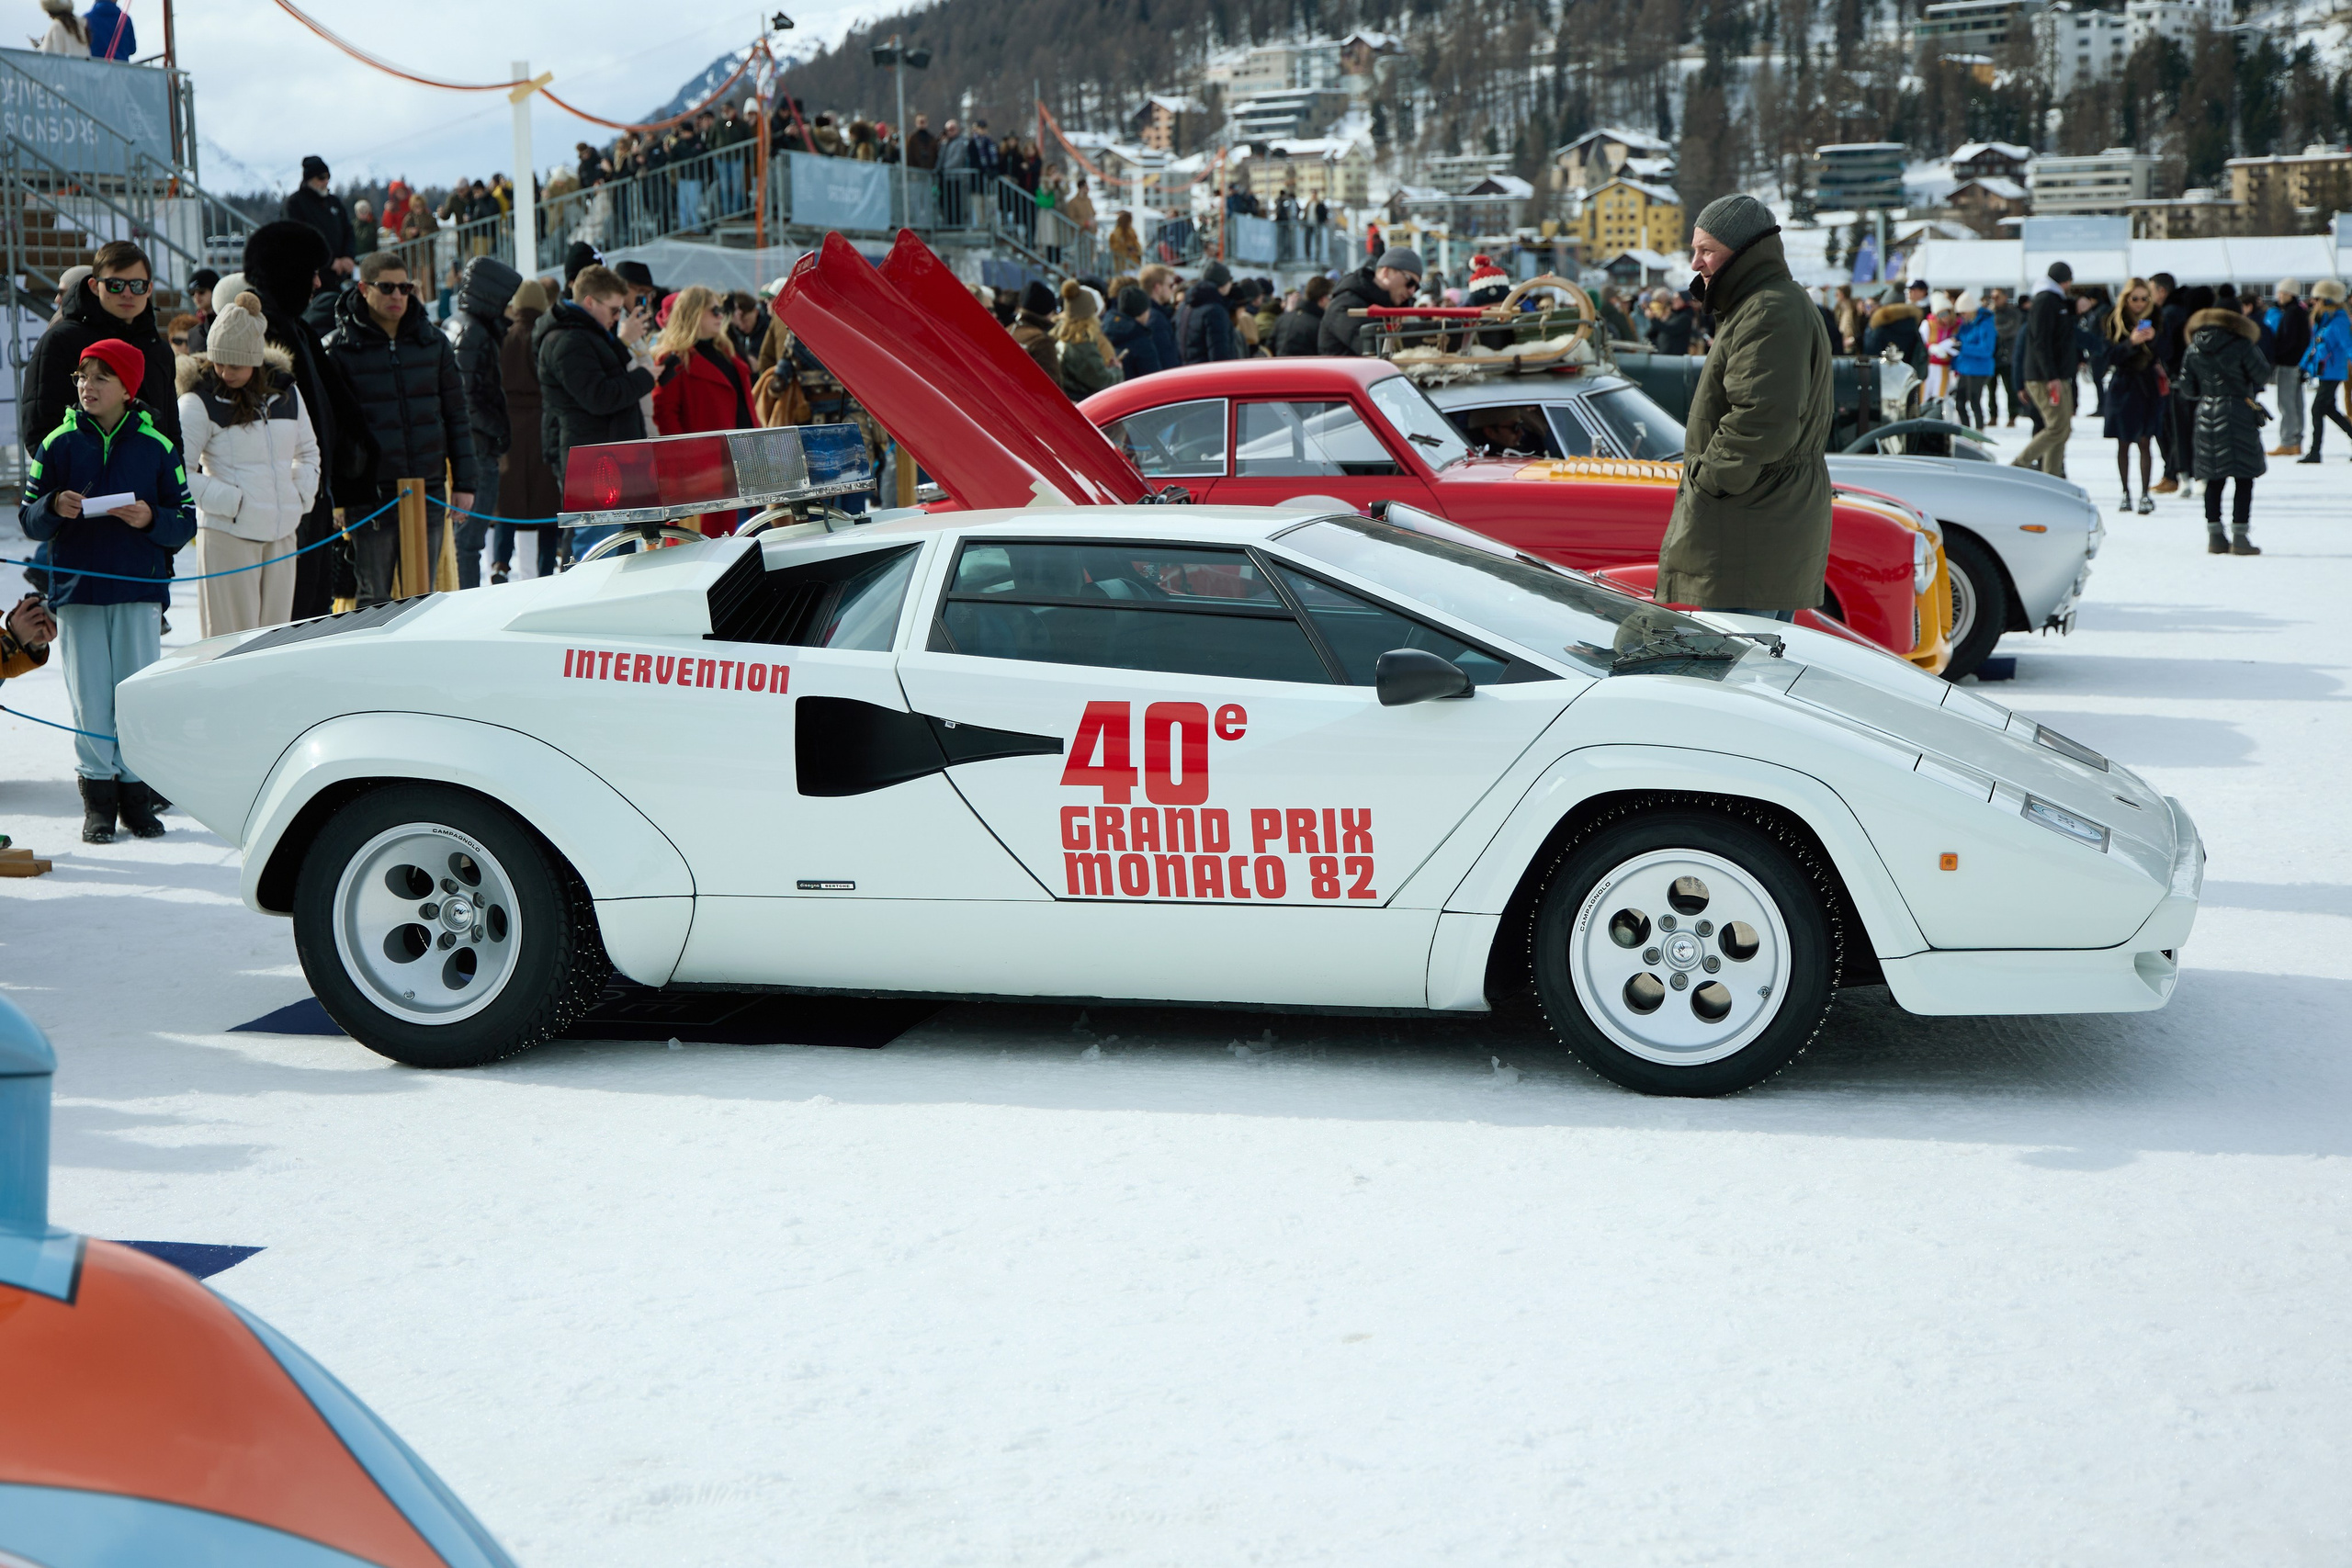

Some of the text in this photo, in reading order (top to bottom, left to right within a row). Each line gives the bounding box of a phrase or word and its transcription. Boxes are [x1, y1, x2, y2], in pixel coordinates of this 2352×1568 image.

[563, 649, 791, 694] INTERVENTION
[432, 828, 481, 852] CAMPAGNOLO
[1059, 806, 1374, 854] GRAND PRIX
[1063, 852, 1377, 899] MONACO 82
[1579, 881, 1611, 932] CAMPAGNOLO
